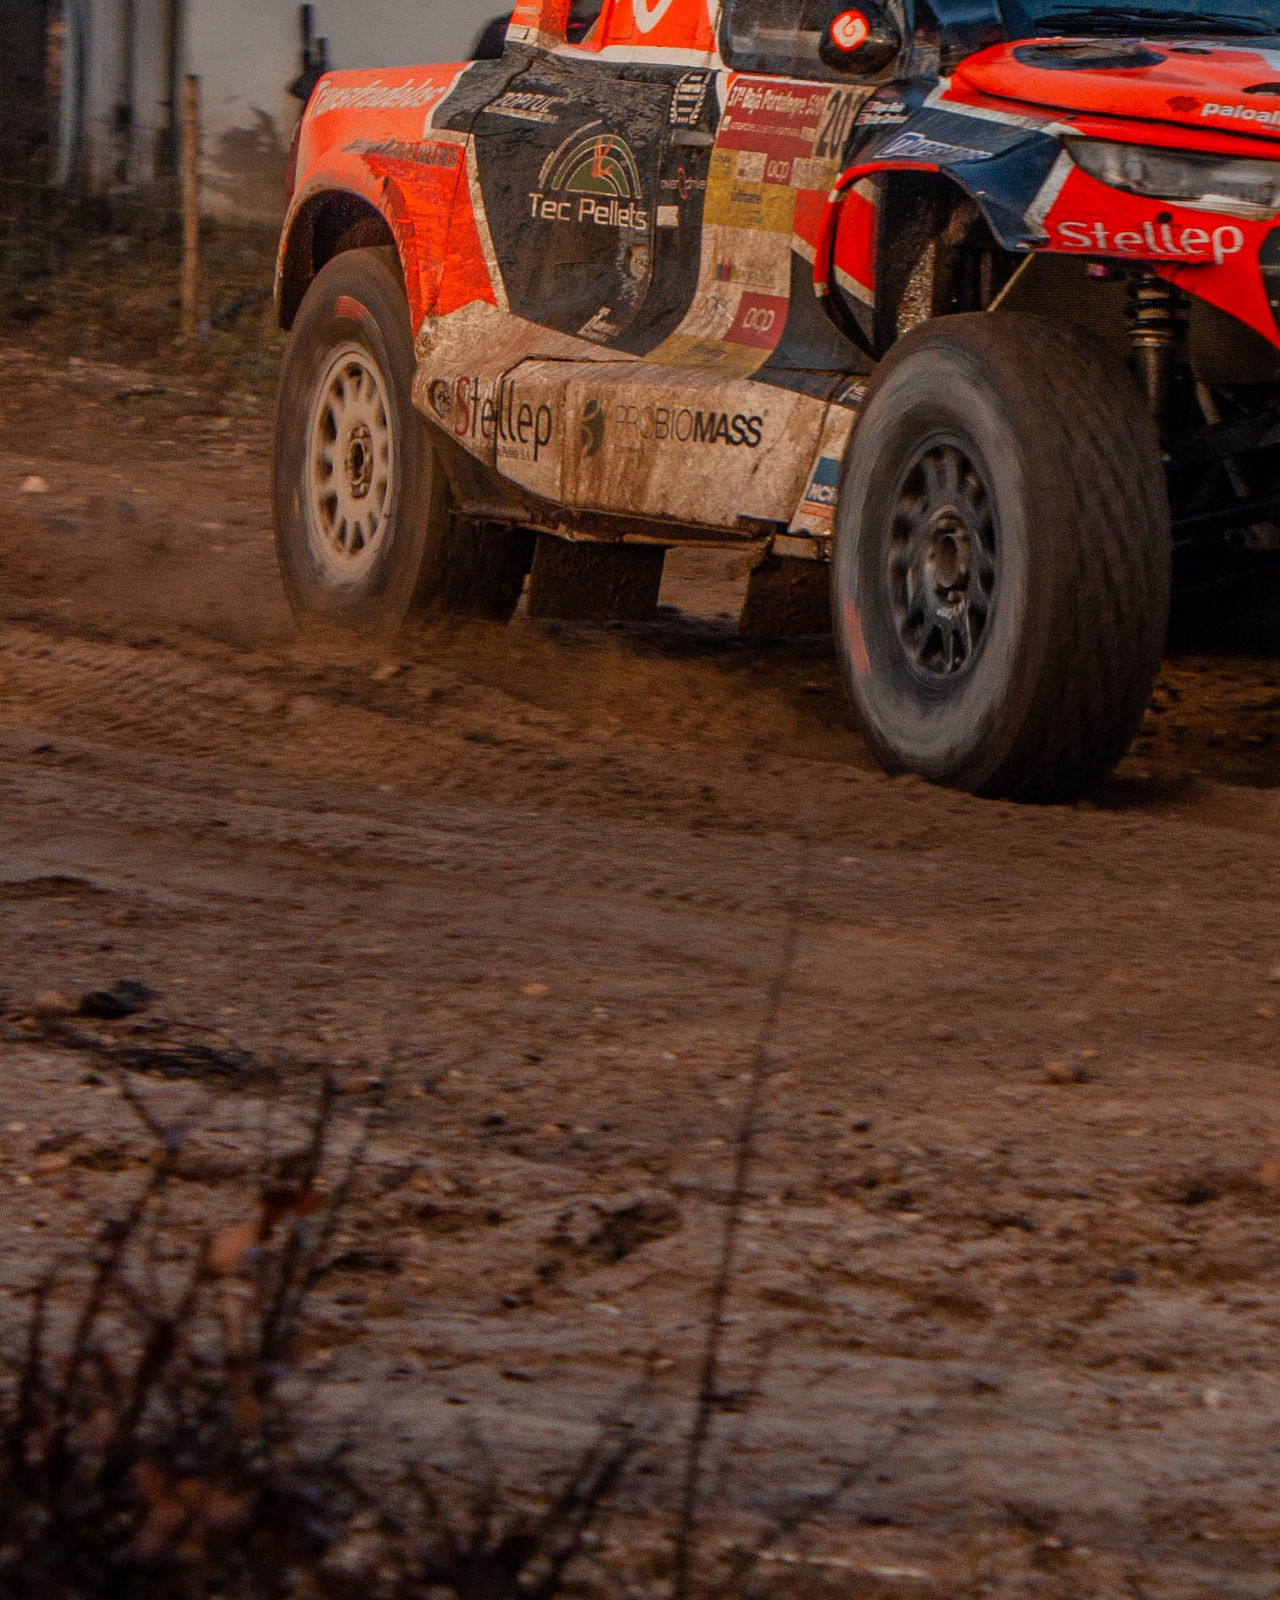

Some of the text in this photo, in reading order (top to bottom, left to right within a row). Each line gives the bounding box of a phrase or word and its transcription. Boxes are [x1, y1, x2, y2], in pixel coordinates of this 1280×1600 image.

[528, 192, 648, 231] Tec Pellets
[1056, 221, 1245, 265] Stellep
[455, 376, 552, 462] Stellep
[615, 405, 763, 448] PROBIOMASS
